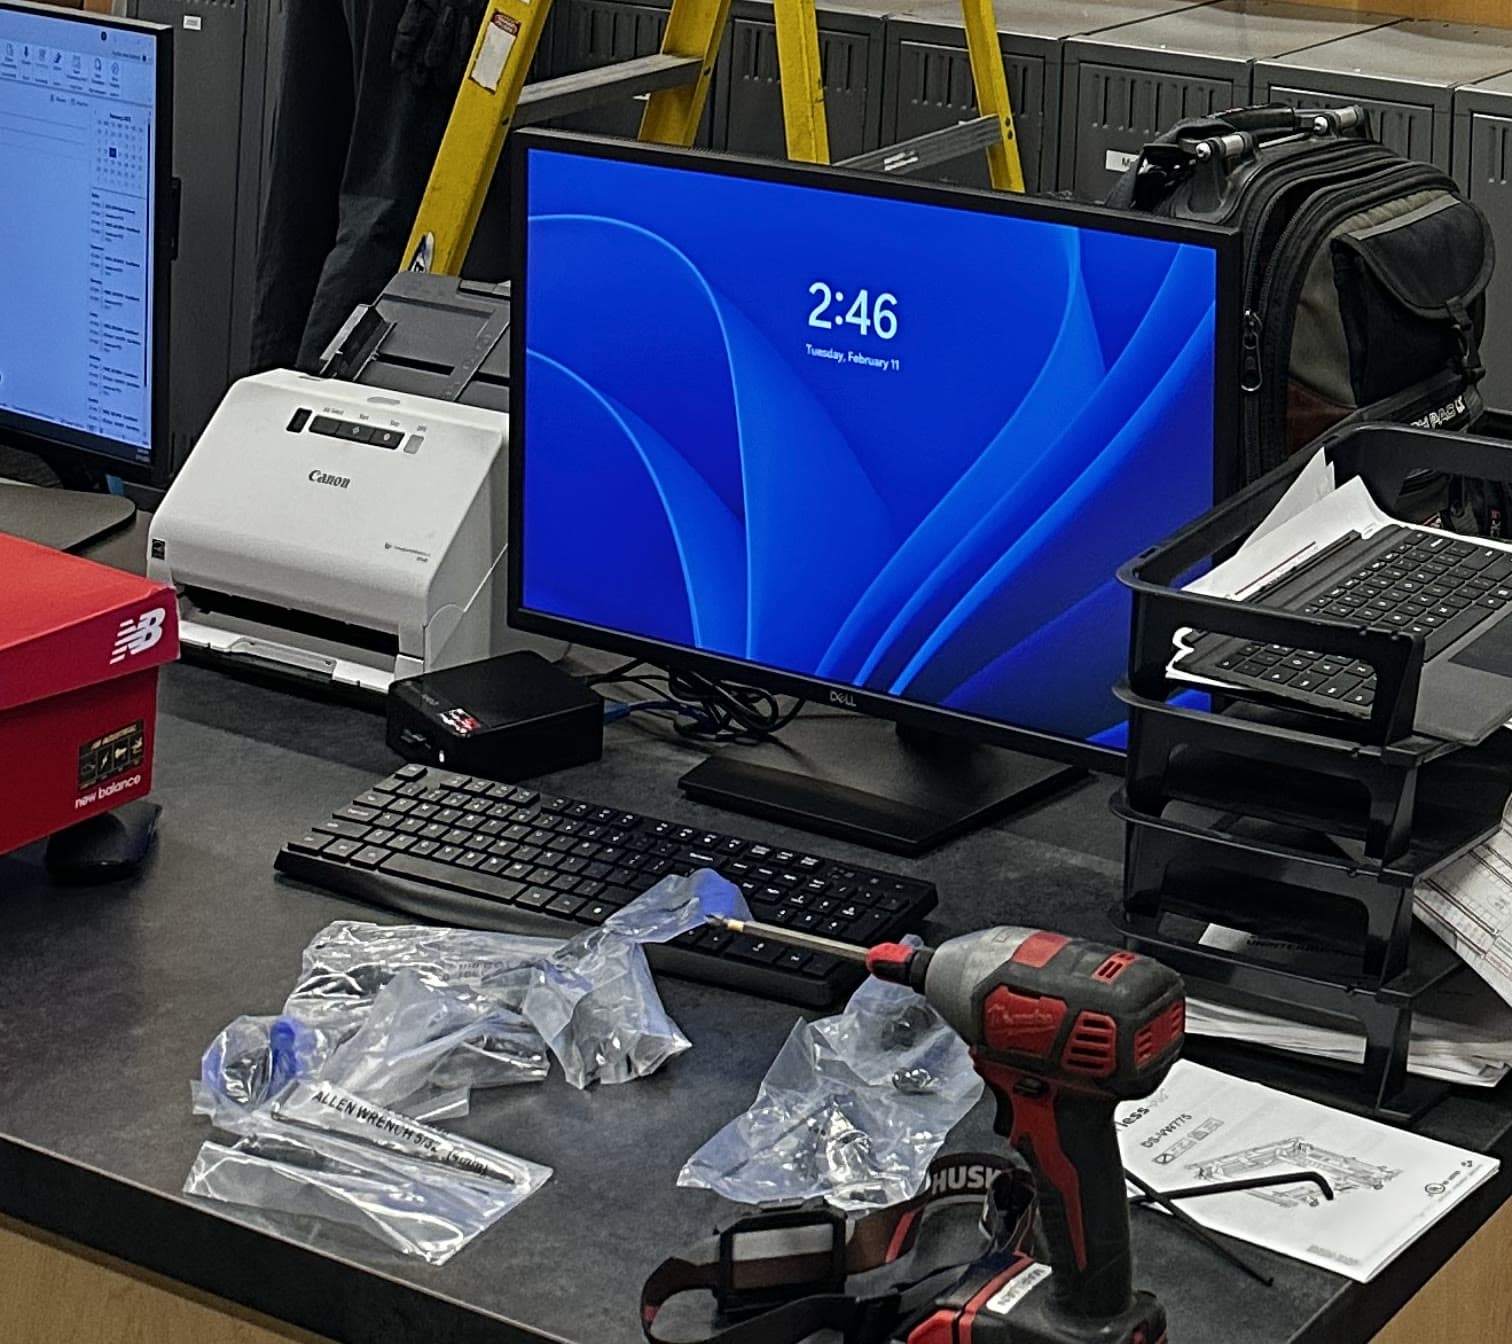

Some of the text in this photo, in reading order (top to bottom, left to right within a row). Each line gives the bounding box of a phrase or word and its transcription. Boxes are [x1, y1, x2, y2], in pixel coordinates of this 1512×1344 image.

[808, 281, 898, 340] 2:46
[805, 343, 900, 371] Tuesday, February 11
[308, 469, 351, 489] Canon
[830, 690, 857, 707] DELL
[74, 789, 98, 810] new
[98, 773, 142, 800] balance
[312, 1090, 358, 1115] ALLEN
[357, 1105, 413, 1140] WRENCH
[931, 1165, 1002, 1196] HUSK
